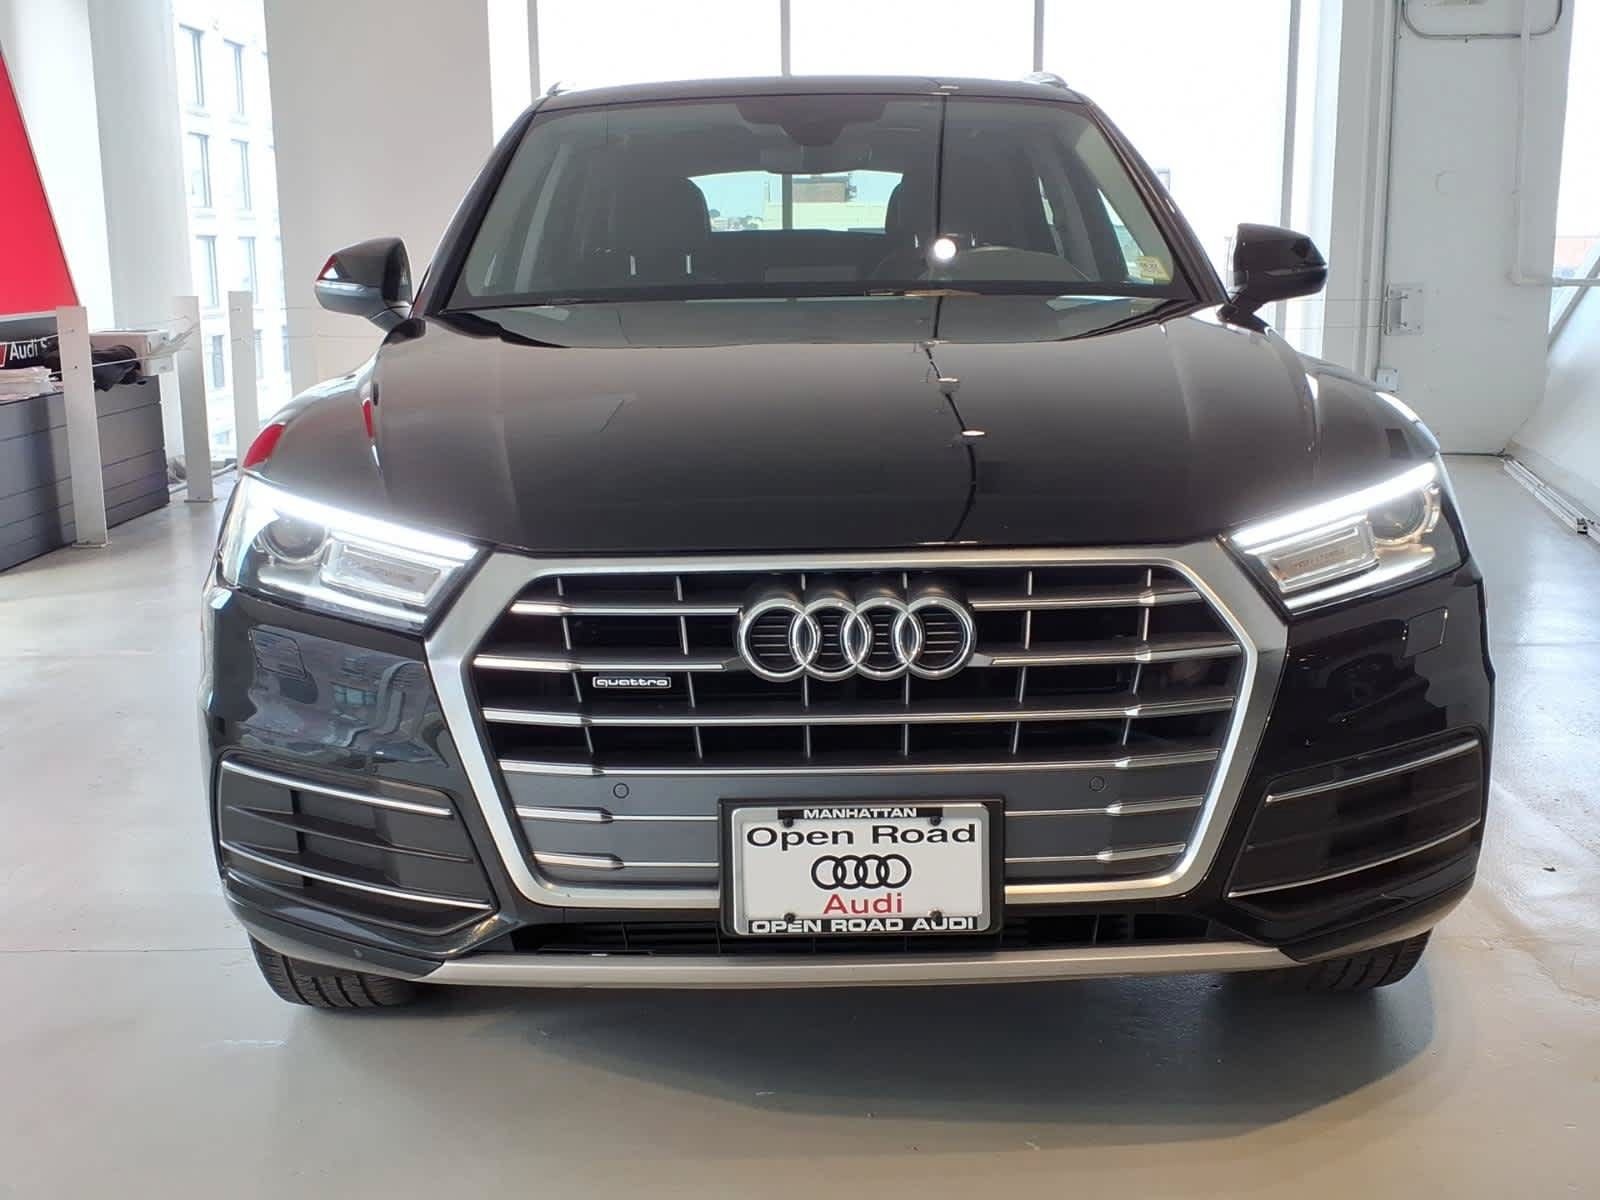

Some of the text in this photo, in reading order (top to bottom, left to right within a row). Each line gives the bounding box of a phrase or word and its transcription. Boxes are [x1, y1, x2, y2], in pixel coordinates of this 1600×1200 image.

[9, 340, 39, 361] Audi
[596, 678, 668, 688] quattro
[803, 808, 917, 819] MANHATTAN
[747, 824, 976, 851] Open Road
[823, 893, 904, 915] Audi
[751, 916, 974, 933] OPEN ROAD AUDI
